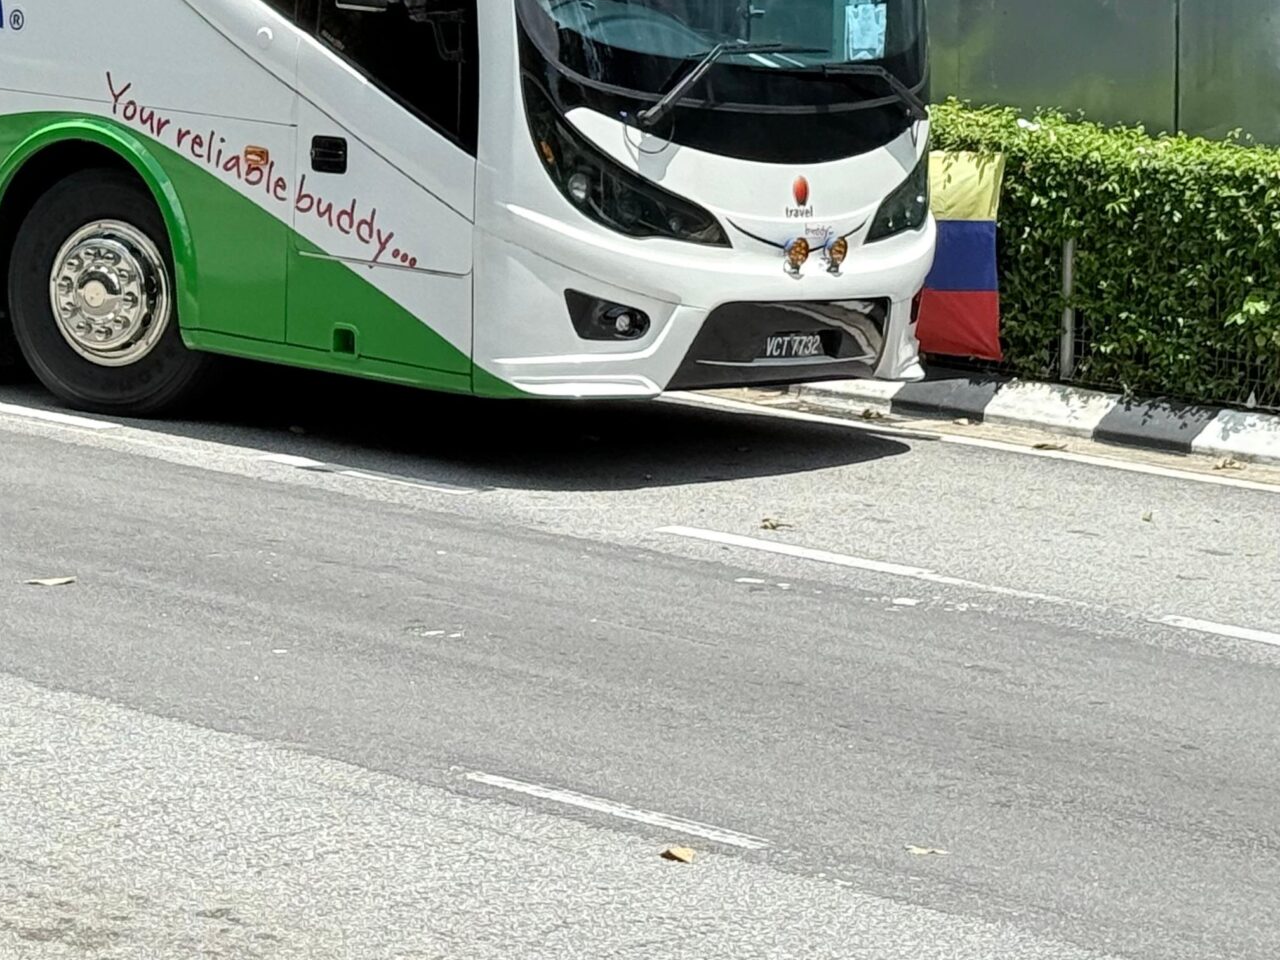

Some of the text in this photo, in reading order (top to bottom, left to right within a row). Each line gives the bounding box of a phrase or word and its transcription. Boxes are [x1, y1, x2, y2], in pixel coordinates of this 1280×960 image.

[106, 72, 170, 138] Your
[177, 130, 287, 201] reliable
[785, 205, 814, 219] travel
[766, 335, 821, 356] VCT 7732
